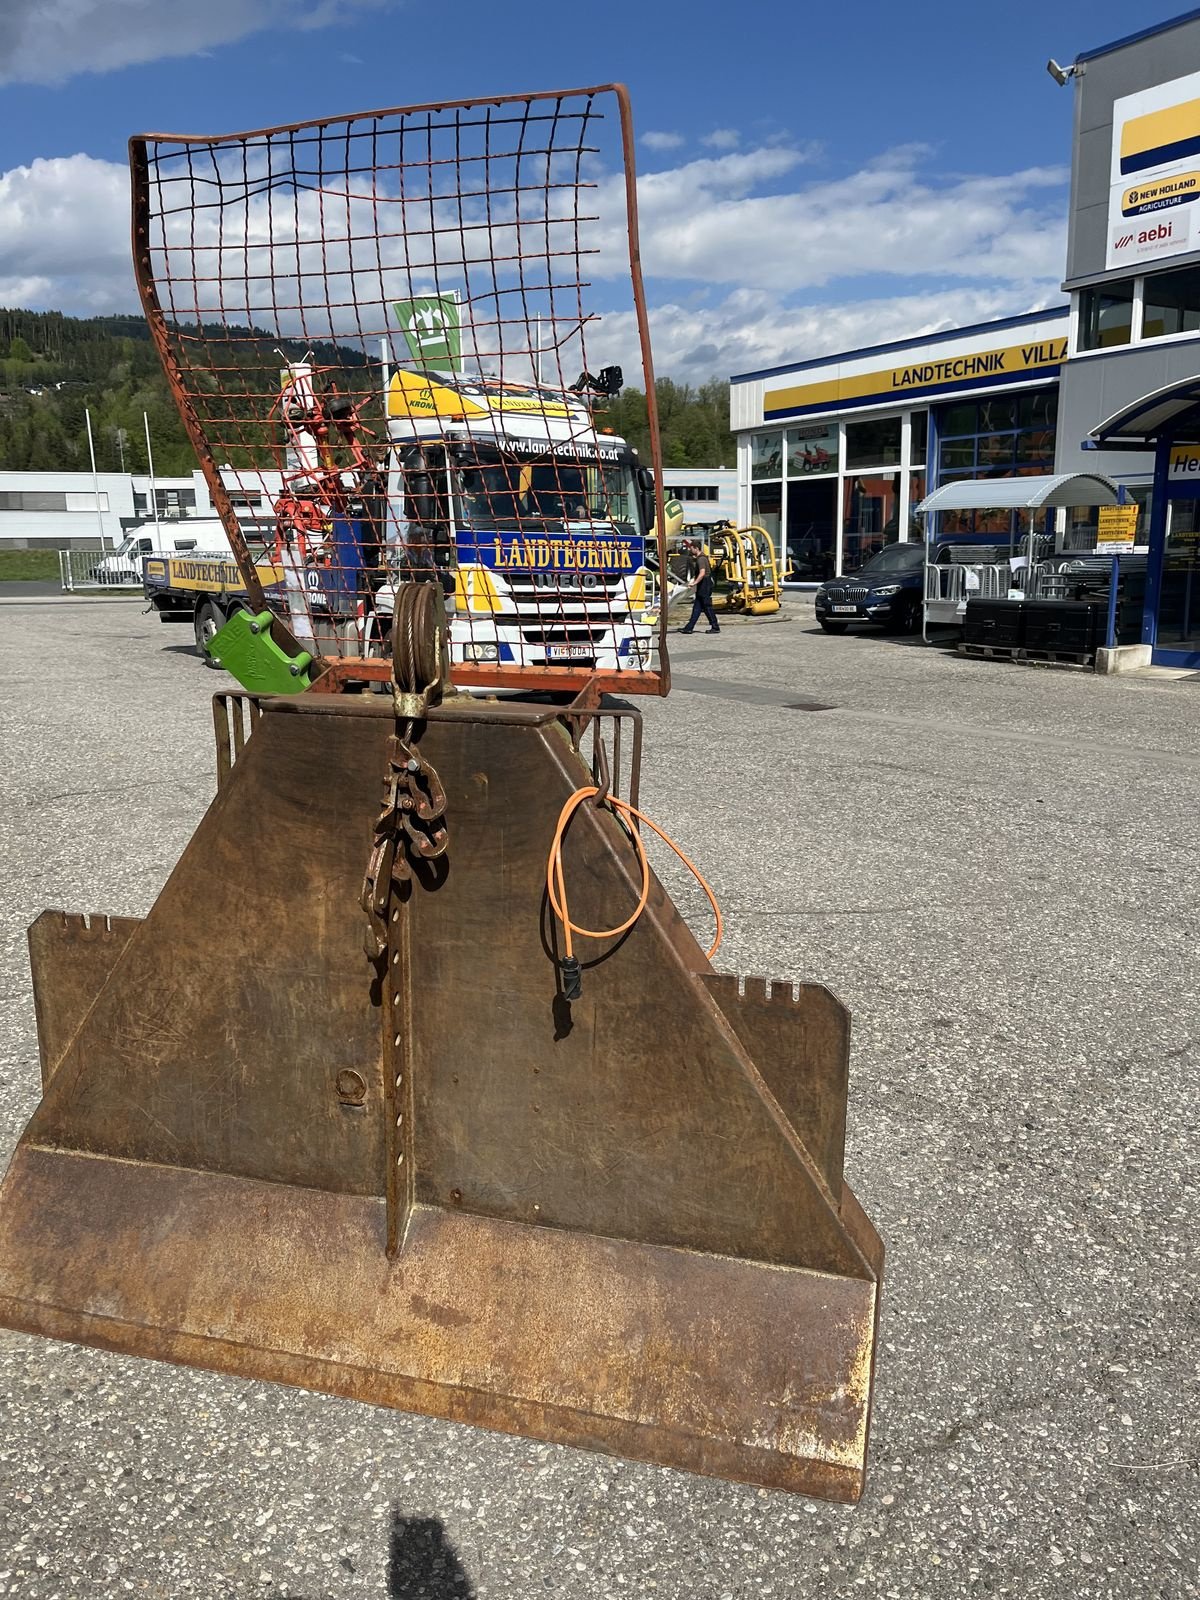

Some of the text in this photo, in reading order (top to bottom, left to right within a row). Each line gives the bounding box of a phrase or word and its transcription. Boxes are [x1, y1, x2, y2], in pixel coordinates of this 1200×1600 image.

[1140, 178, 1196, 200] NEW HOLLAND
[1138, 195, 1182, 213] AGRICULTURE
[1138, 221, 1172, 243] aebi
[892, 352, 1005, 387] LANDTECHNIK
[1173, 454, 1200, 473] He
[493, 537, 633, 569] LANDTECHNIK
[537, 573, 598, 589] IVECO
